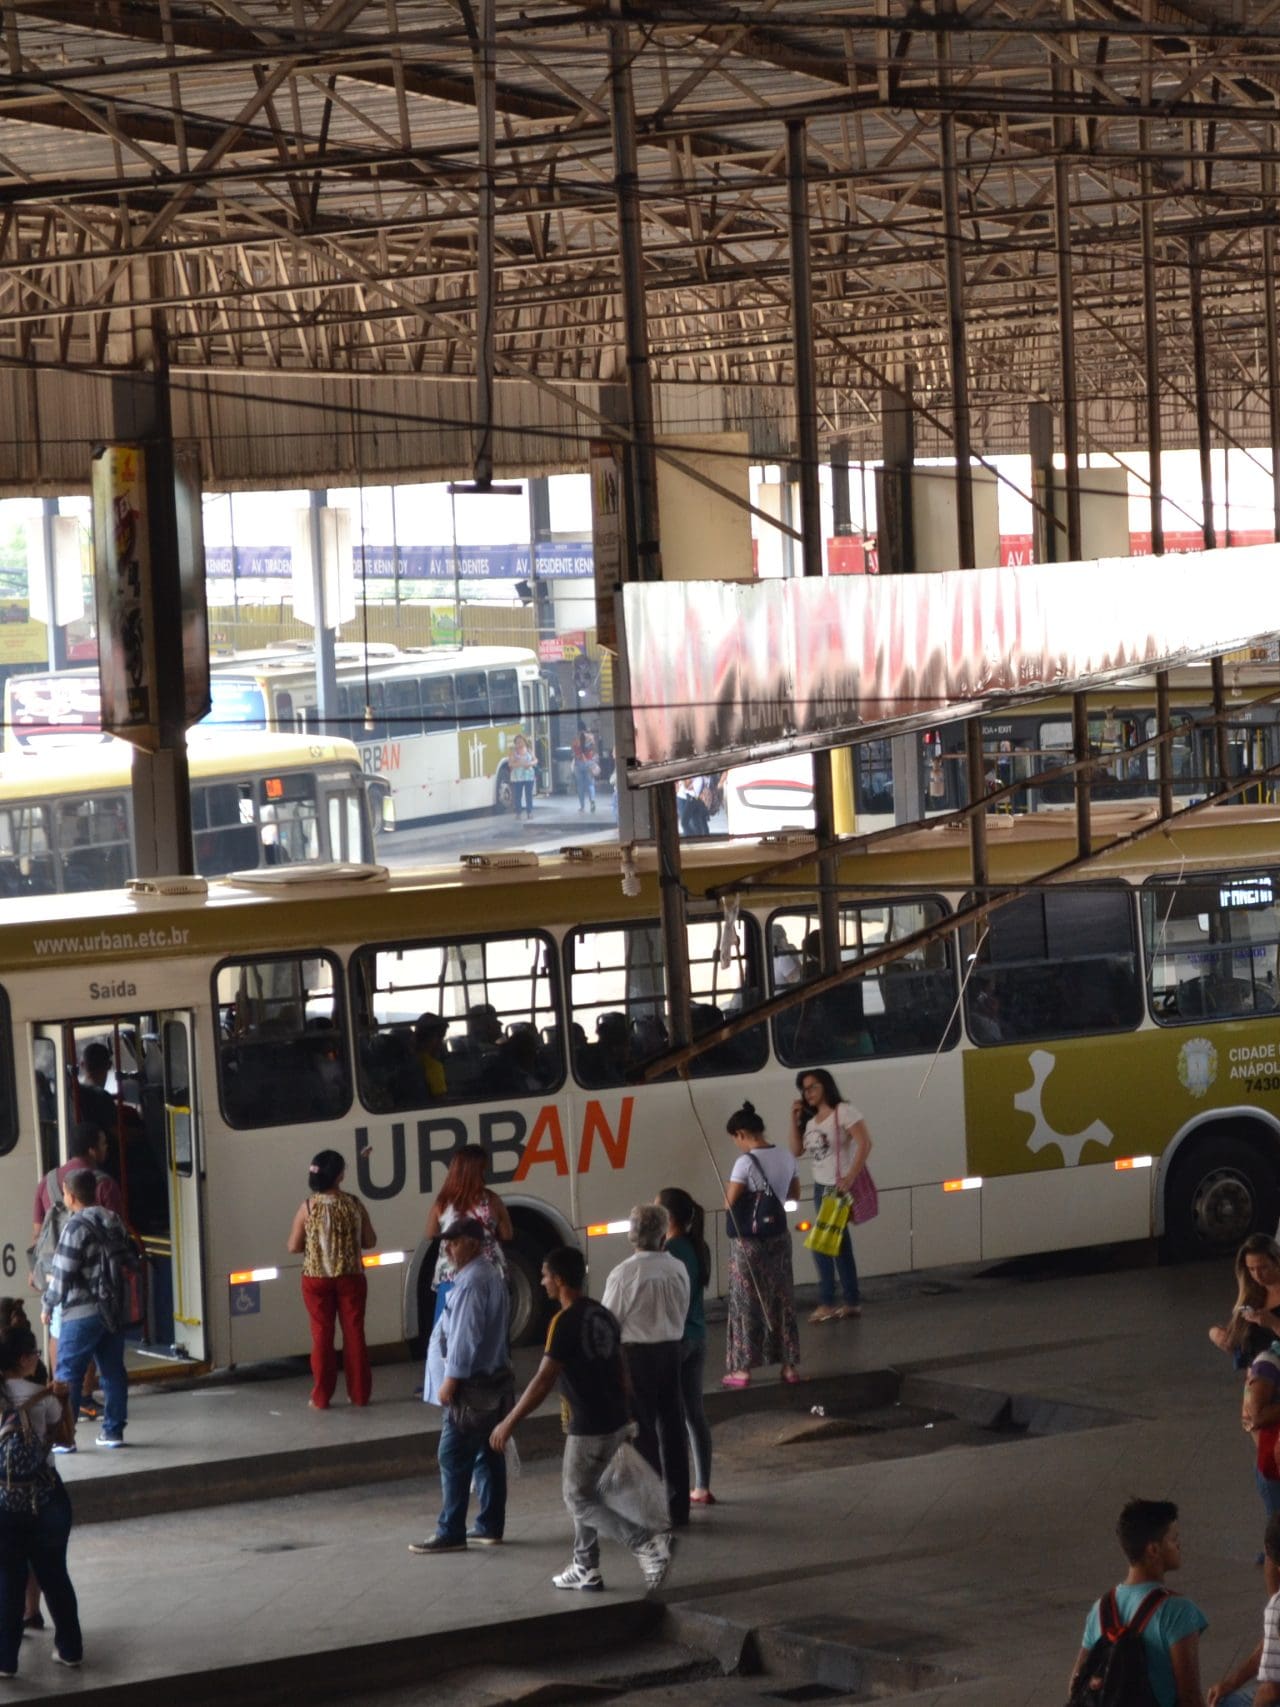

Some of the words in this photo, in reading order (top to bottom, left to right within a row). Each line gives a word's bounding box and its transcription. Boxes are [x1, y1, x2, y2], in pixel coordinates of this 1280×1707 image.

[206, 559, 232, 573] KENNED
[374, 558, 408, 573] KENNDY
[430, 559, 444, 573] AV.
[535, 557, 573, 575] RESIDENTE
[33, 926, 189, 955] www.urban.etc.br
[1229, 1044, 1276, 1062] CIDADE
[355, 1096, 634, 1201] URBAN
[3, 1243, 16, 1278] 6
